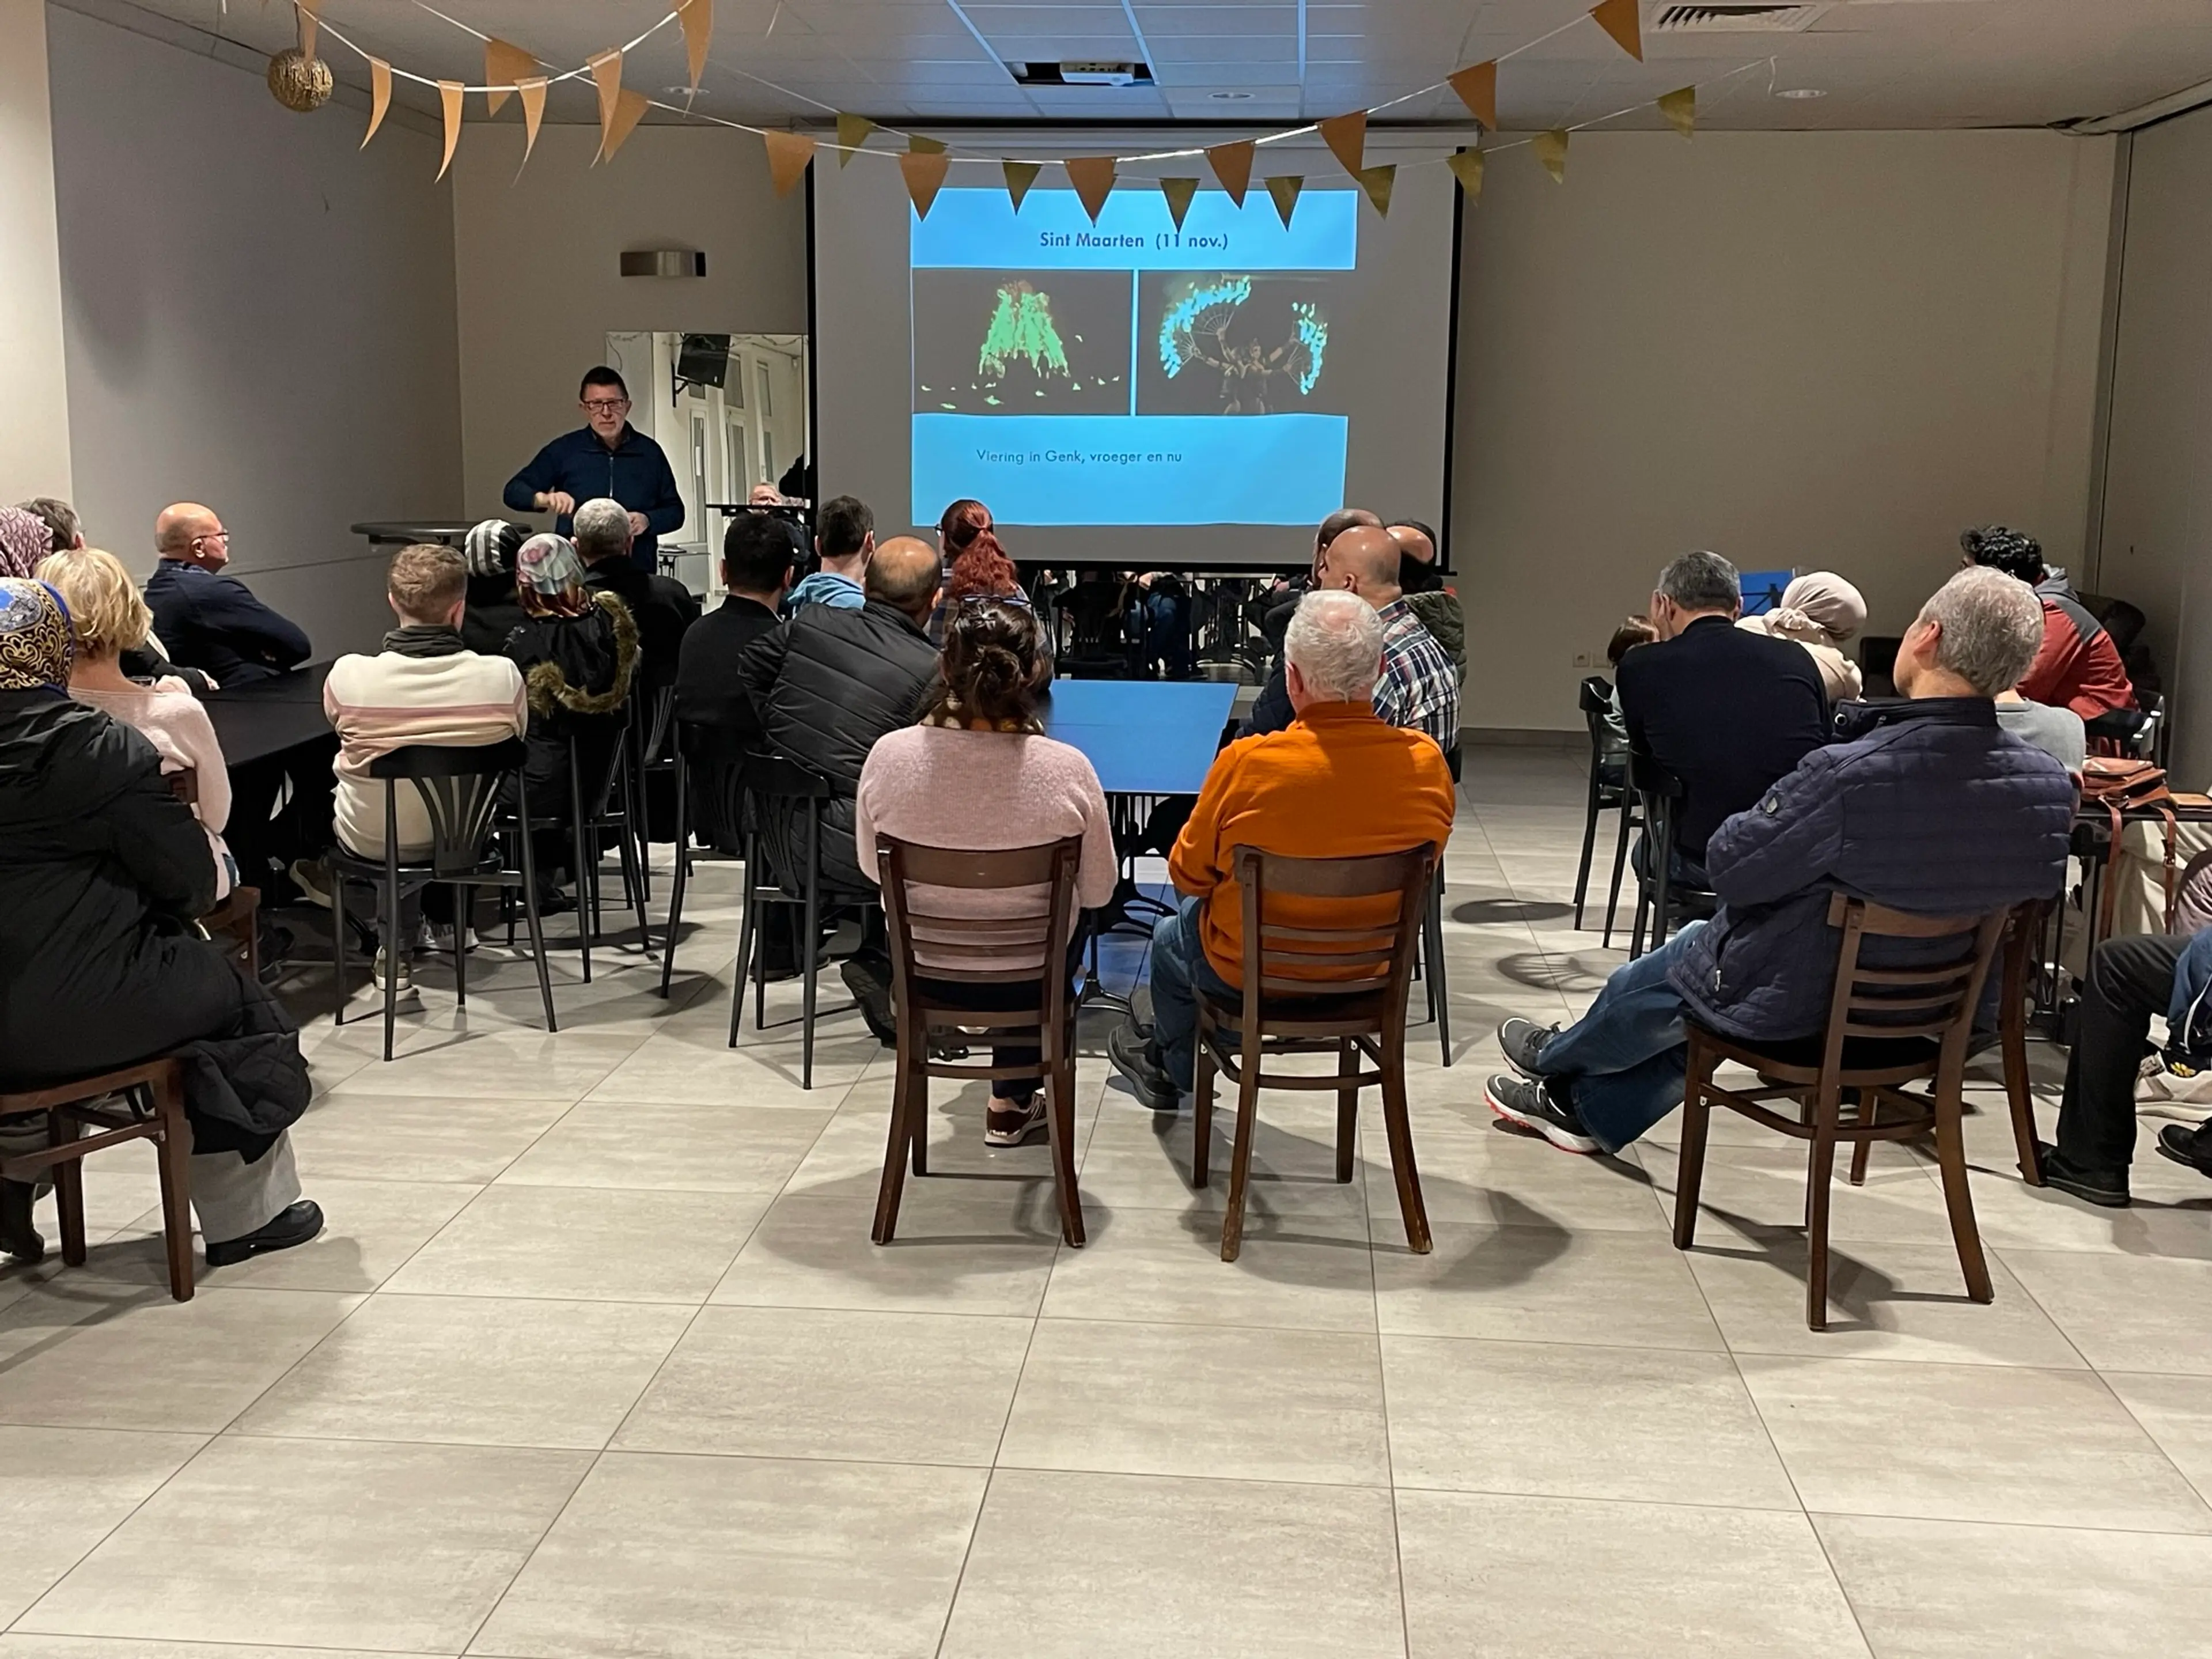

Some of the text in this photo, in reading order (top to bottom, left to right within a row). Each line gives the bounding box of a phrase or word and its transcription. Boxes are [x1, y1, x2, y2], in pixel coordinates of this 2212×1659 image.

[1040, 232, 1228, 250] Sint Maarten (11 nov.)
[976, 449, 1182, 465] Viering in Genk, vroeger en nu
